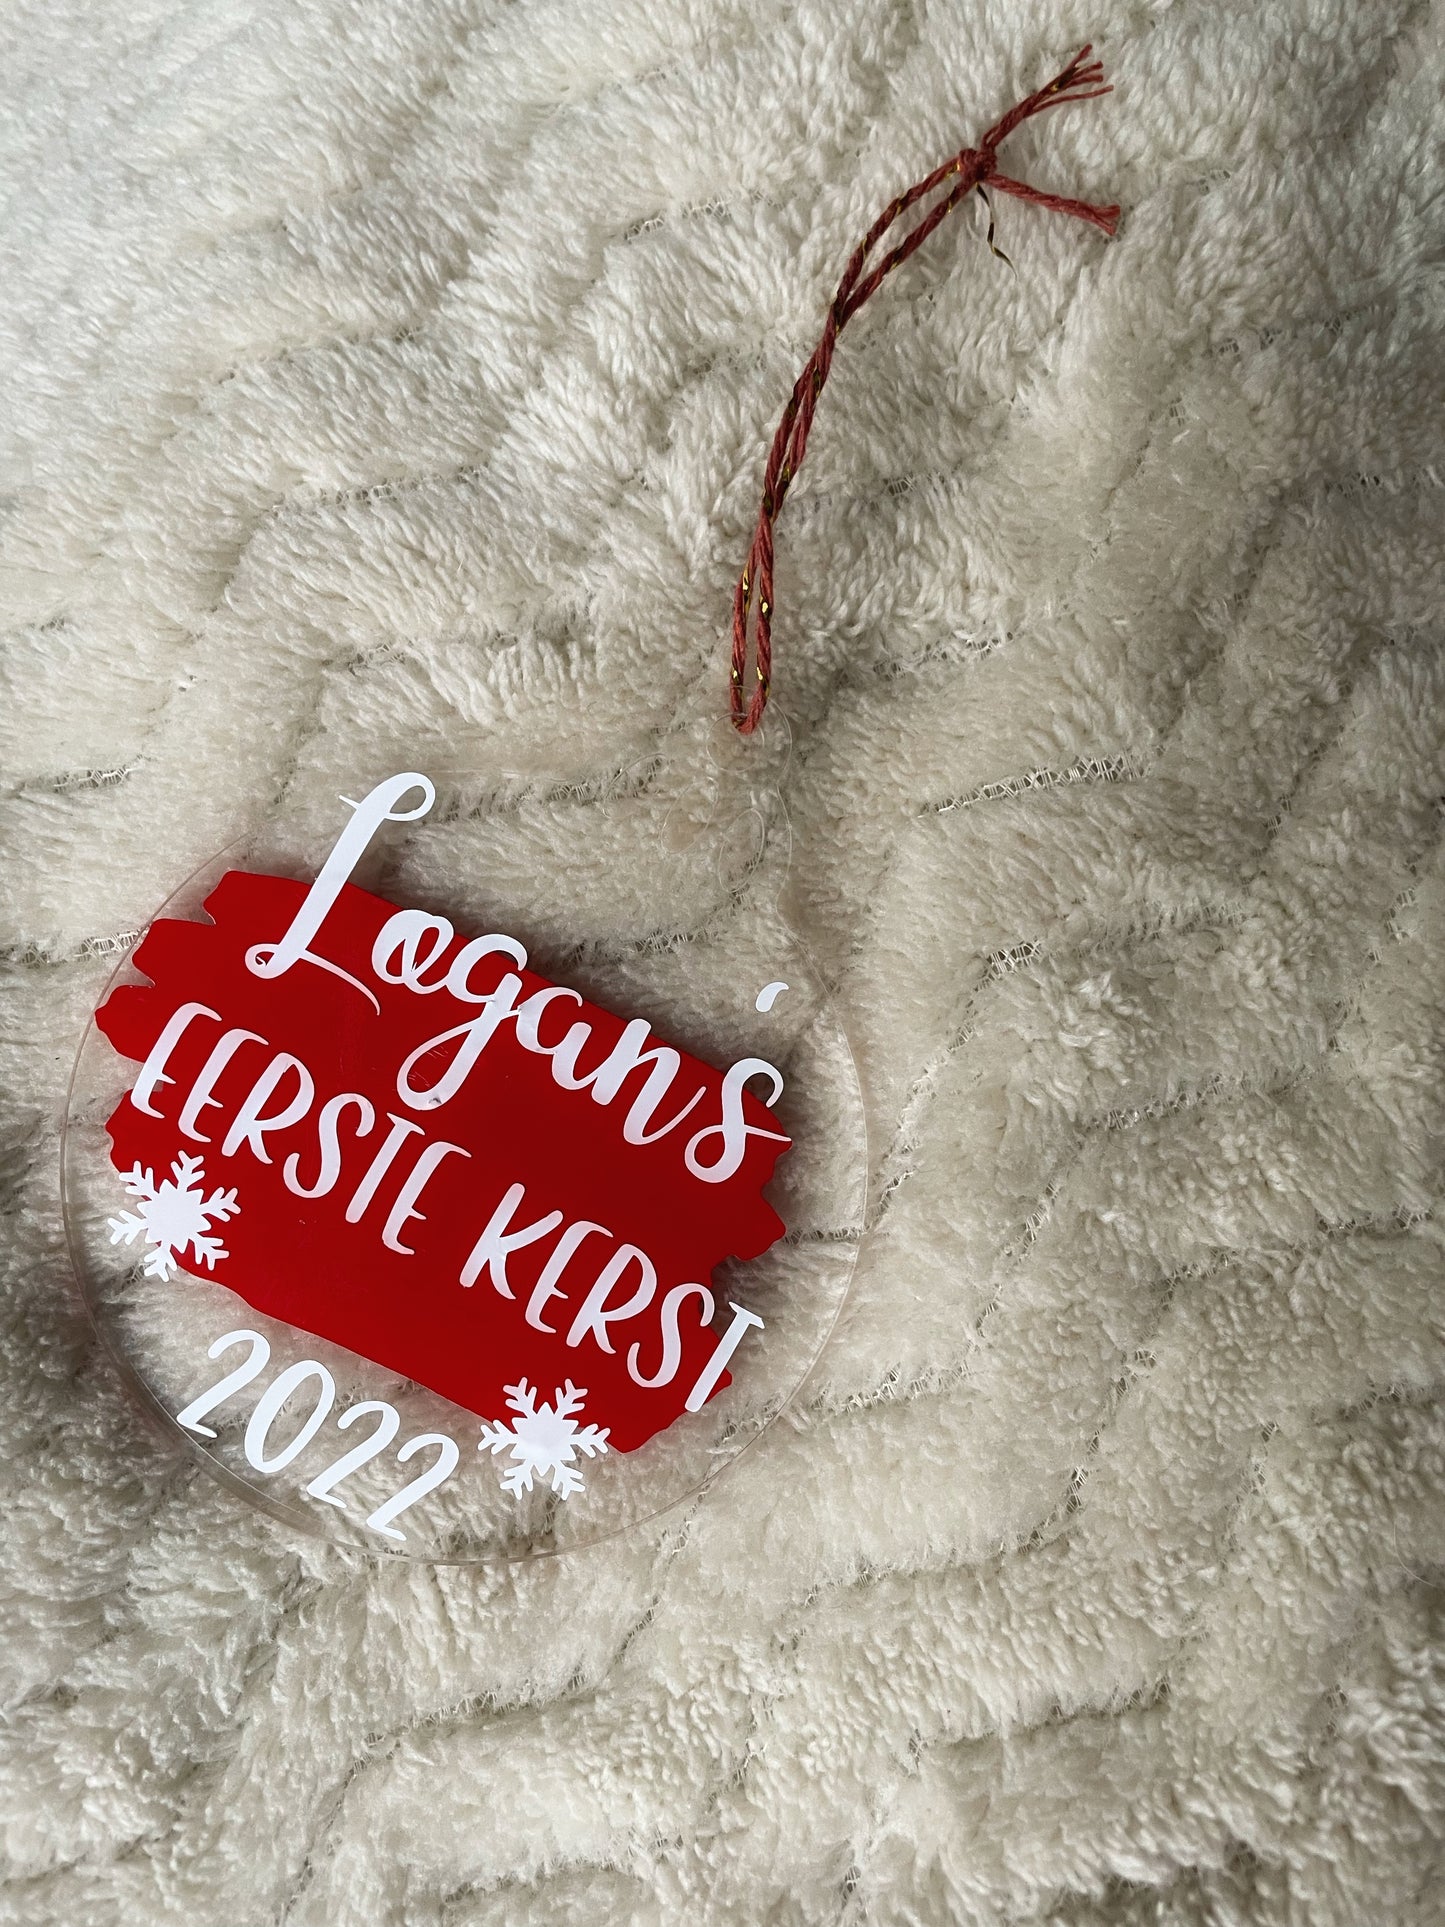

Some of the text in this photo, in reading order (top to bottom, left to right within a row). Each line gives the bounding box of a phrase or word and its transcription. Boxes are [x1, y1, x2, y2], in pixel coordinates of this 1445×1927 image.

[129, 1001, 766, 1413] EERSTE KERST
[176, 1328, 460, 1542] 2022
